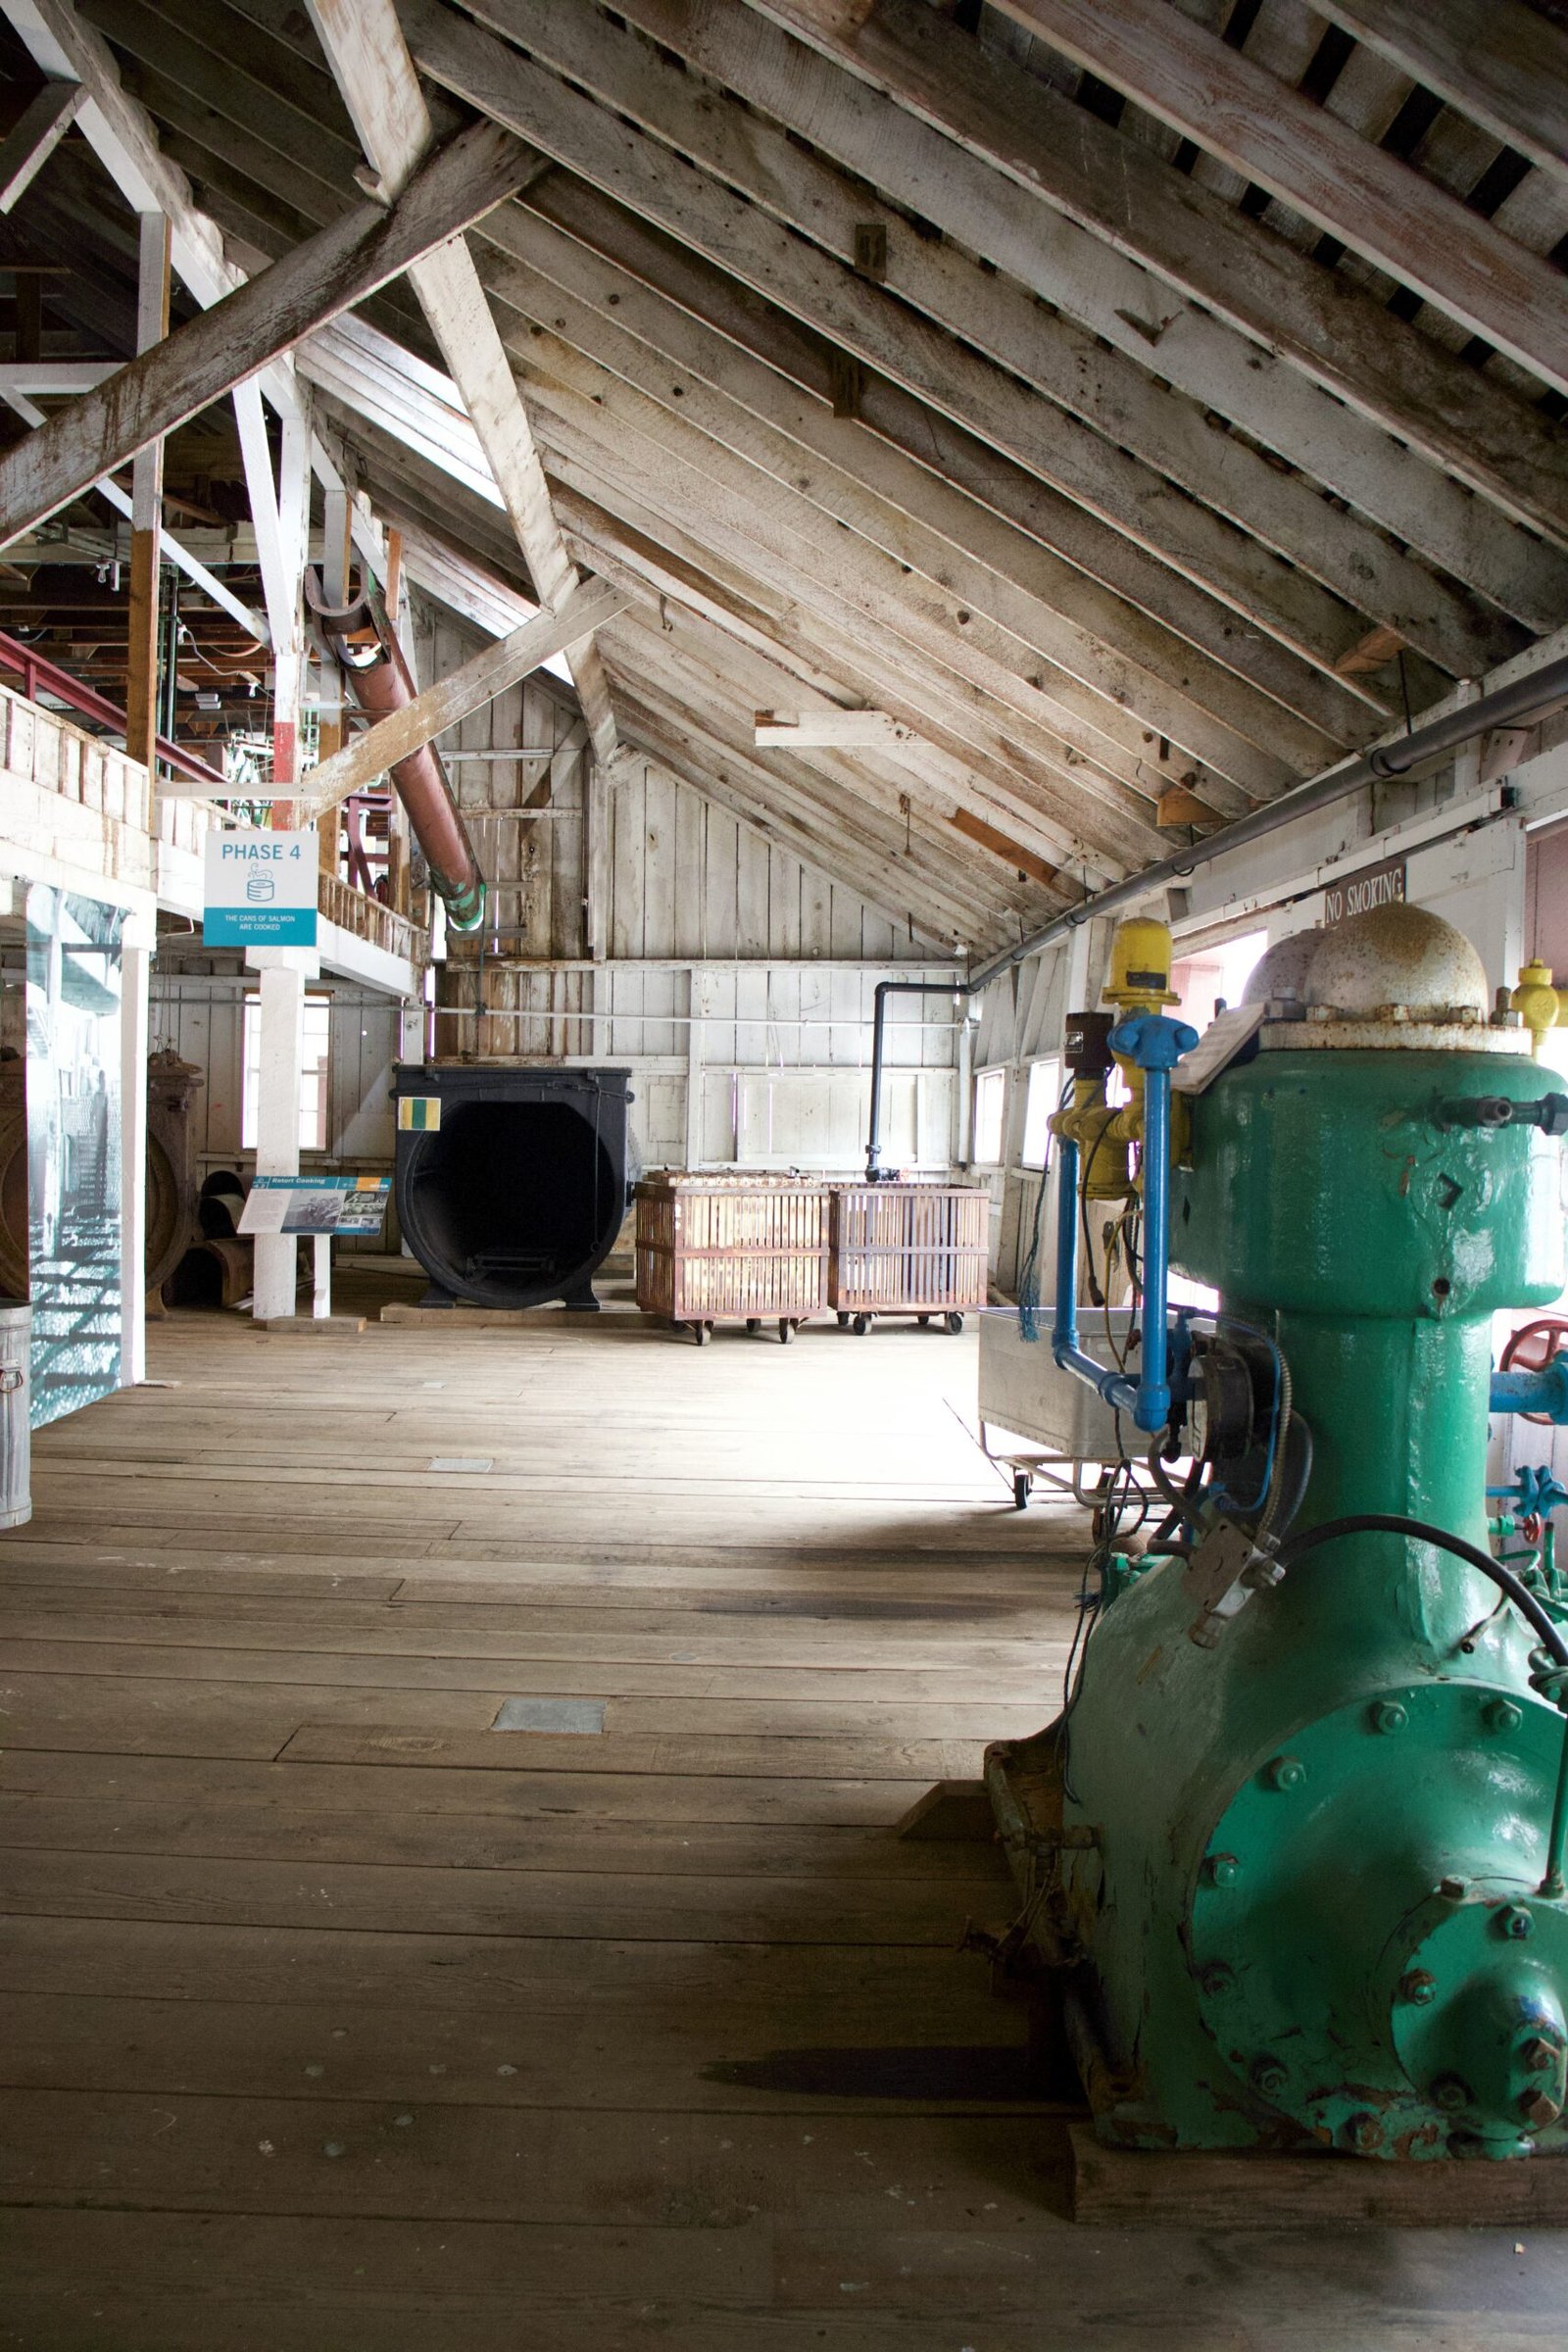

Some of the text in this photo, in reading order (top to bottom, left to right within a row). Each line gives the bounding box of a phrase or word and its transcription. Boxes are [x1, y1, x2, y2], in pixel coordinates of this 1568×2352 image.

[221, 844, 301, 860] PHASE 4
[1326, 867, 1401, 924] NO SMOKING
